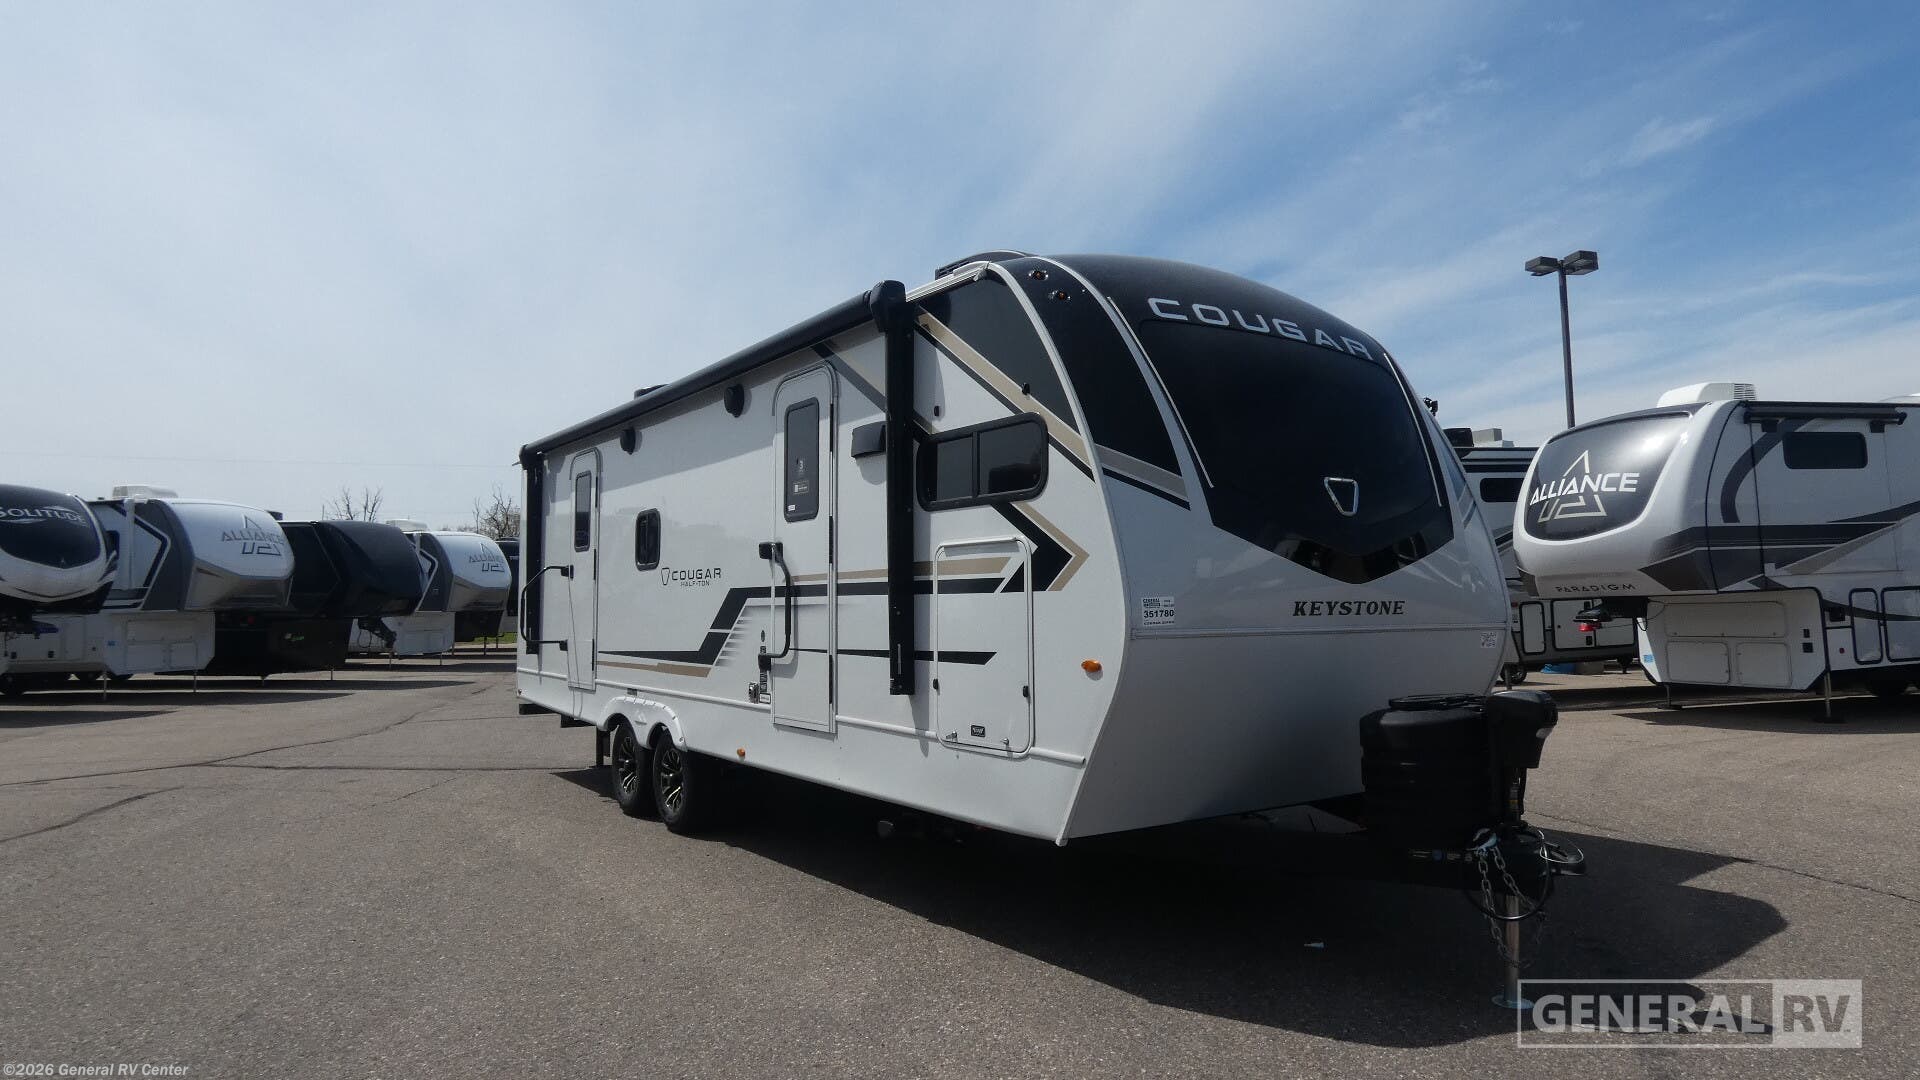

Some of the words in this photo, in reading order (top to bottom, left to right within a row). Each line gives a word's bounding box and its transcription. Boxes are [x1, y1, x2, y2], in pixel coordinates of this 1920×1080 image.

[1147, 297, 1374, 361] COUGAR
[1529, 472, 1640, 506] ALLIANCE
[671, 567, 721, 581] COUGAR
[1555, 583, 1636, 593] PARADIGM
[1143, 609, 1175, 618] 351780
[1292, 600, 1406, 617] KEYSTONE
